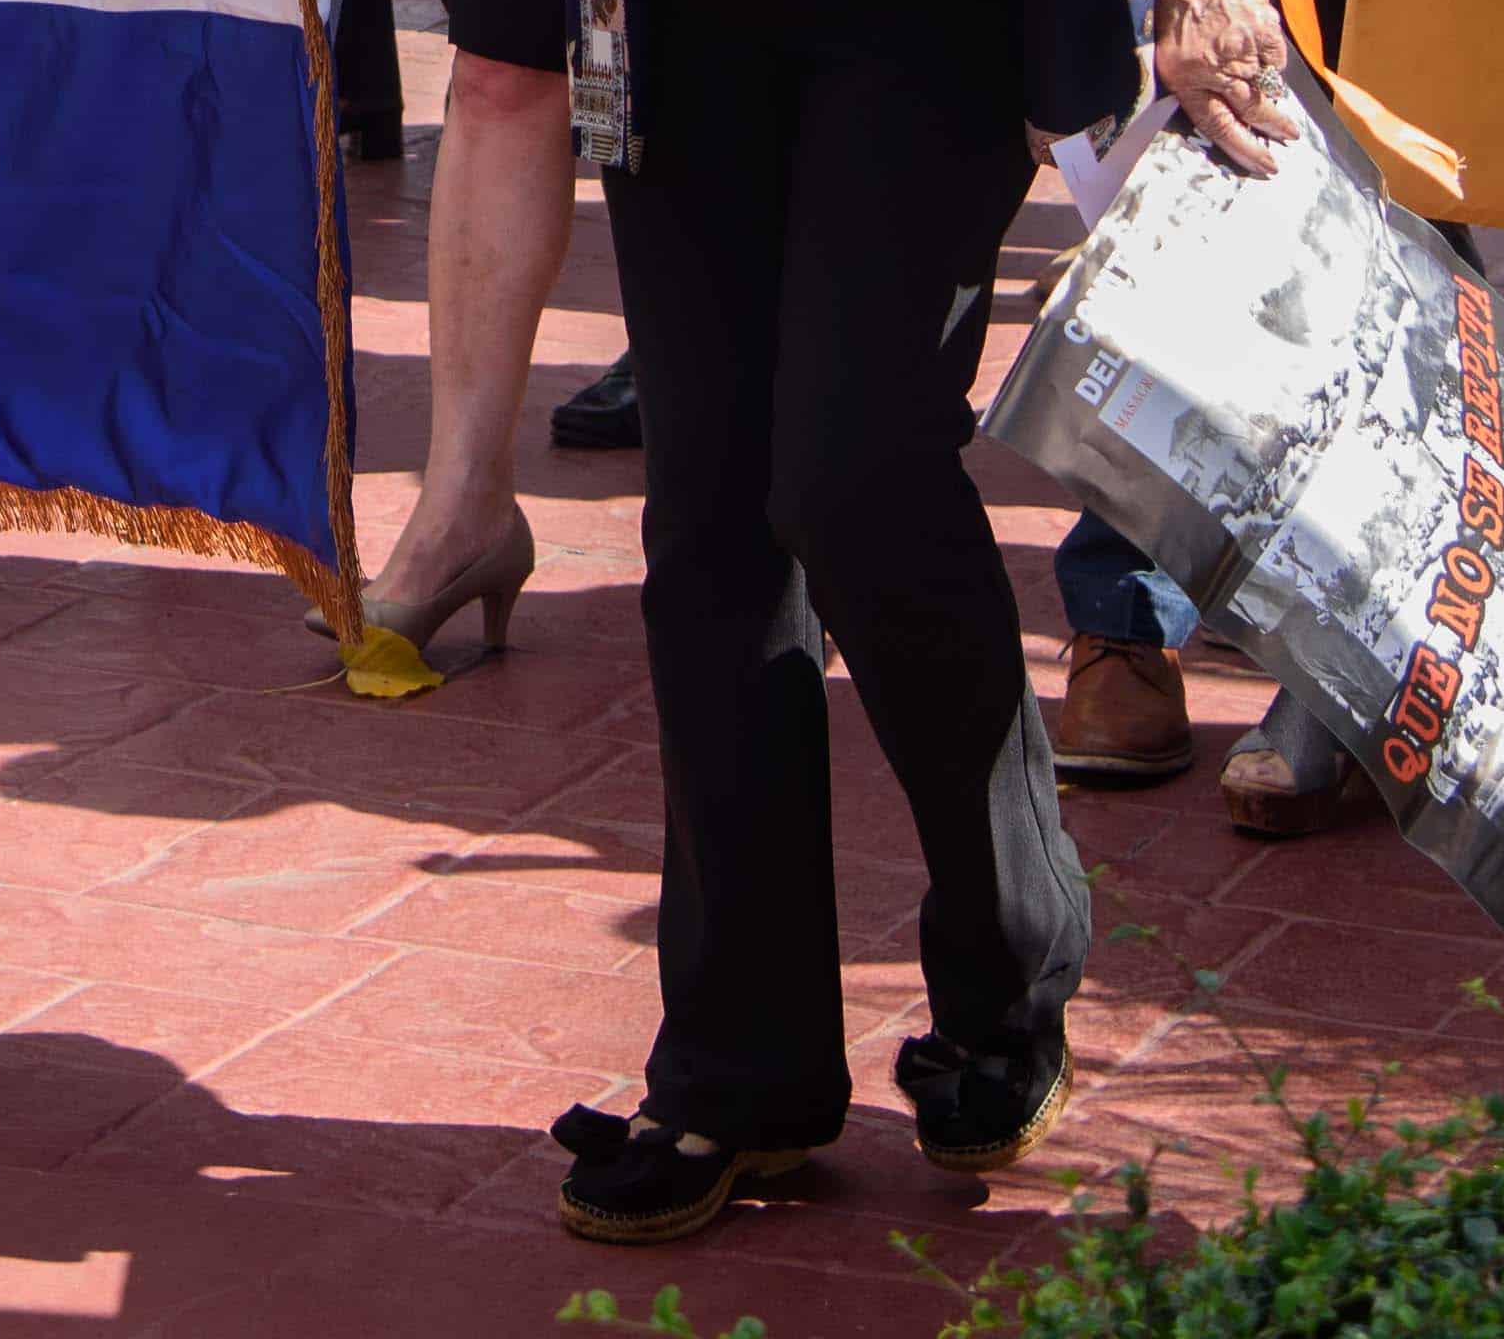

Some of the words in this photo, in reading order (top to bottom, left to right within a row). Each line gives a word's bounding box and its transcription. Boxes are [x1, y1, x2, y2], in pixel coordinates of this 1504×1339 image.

[1075, 349, 1126, 407] DEL
[1383, 643, 1462, 783] QUE
[1426, 544, 1495, 652] NO
